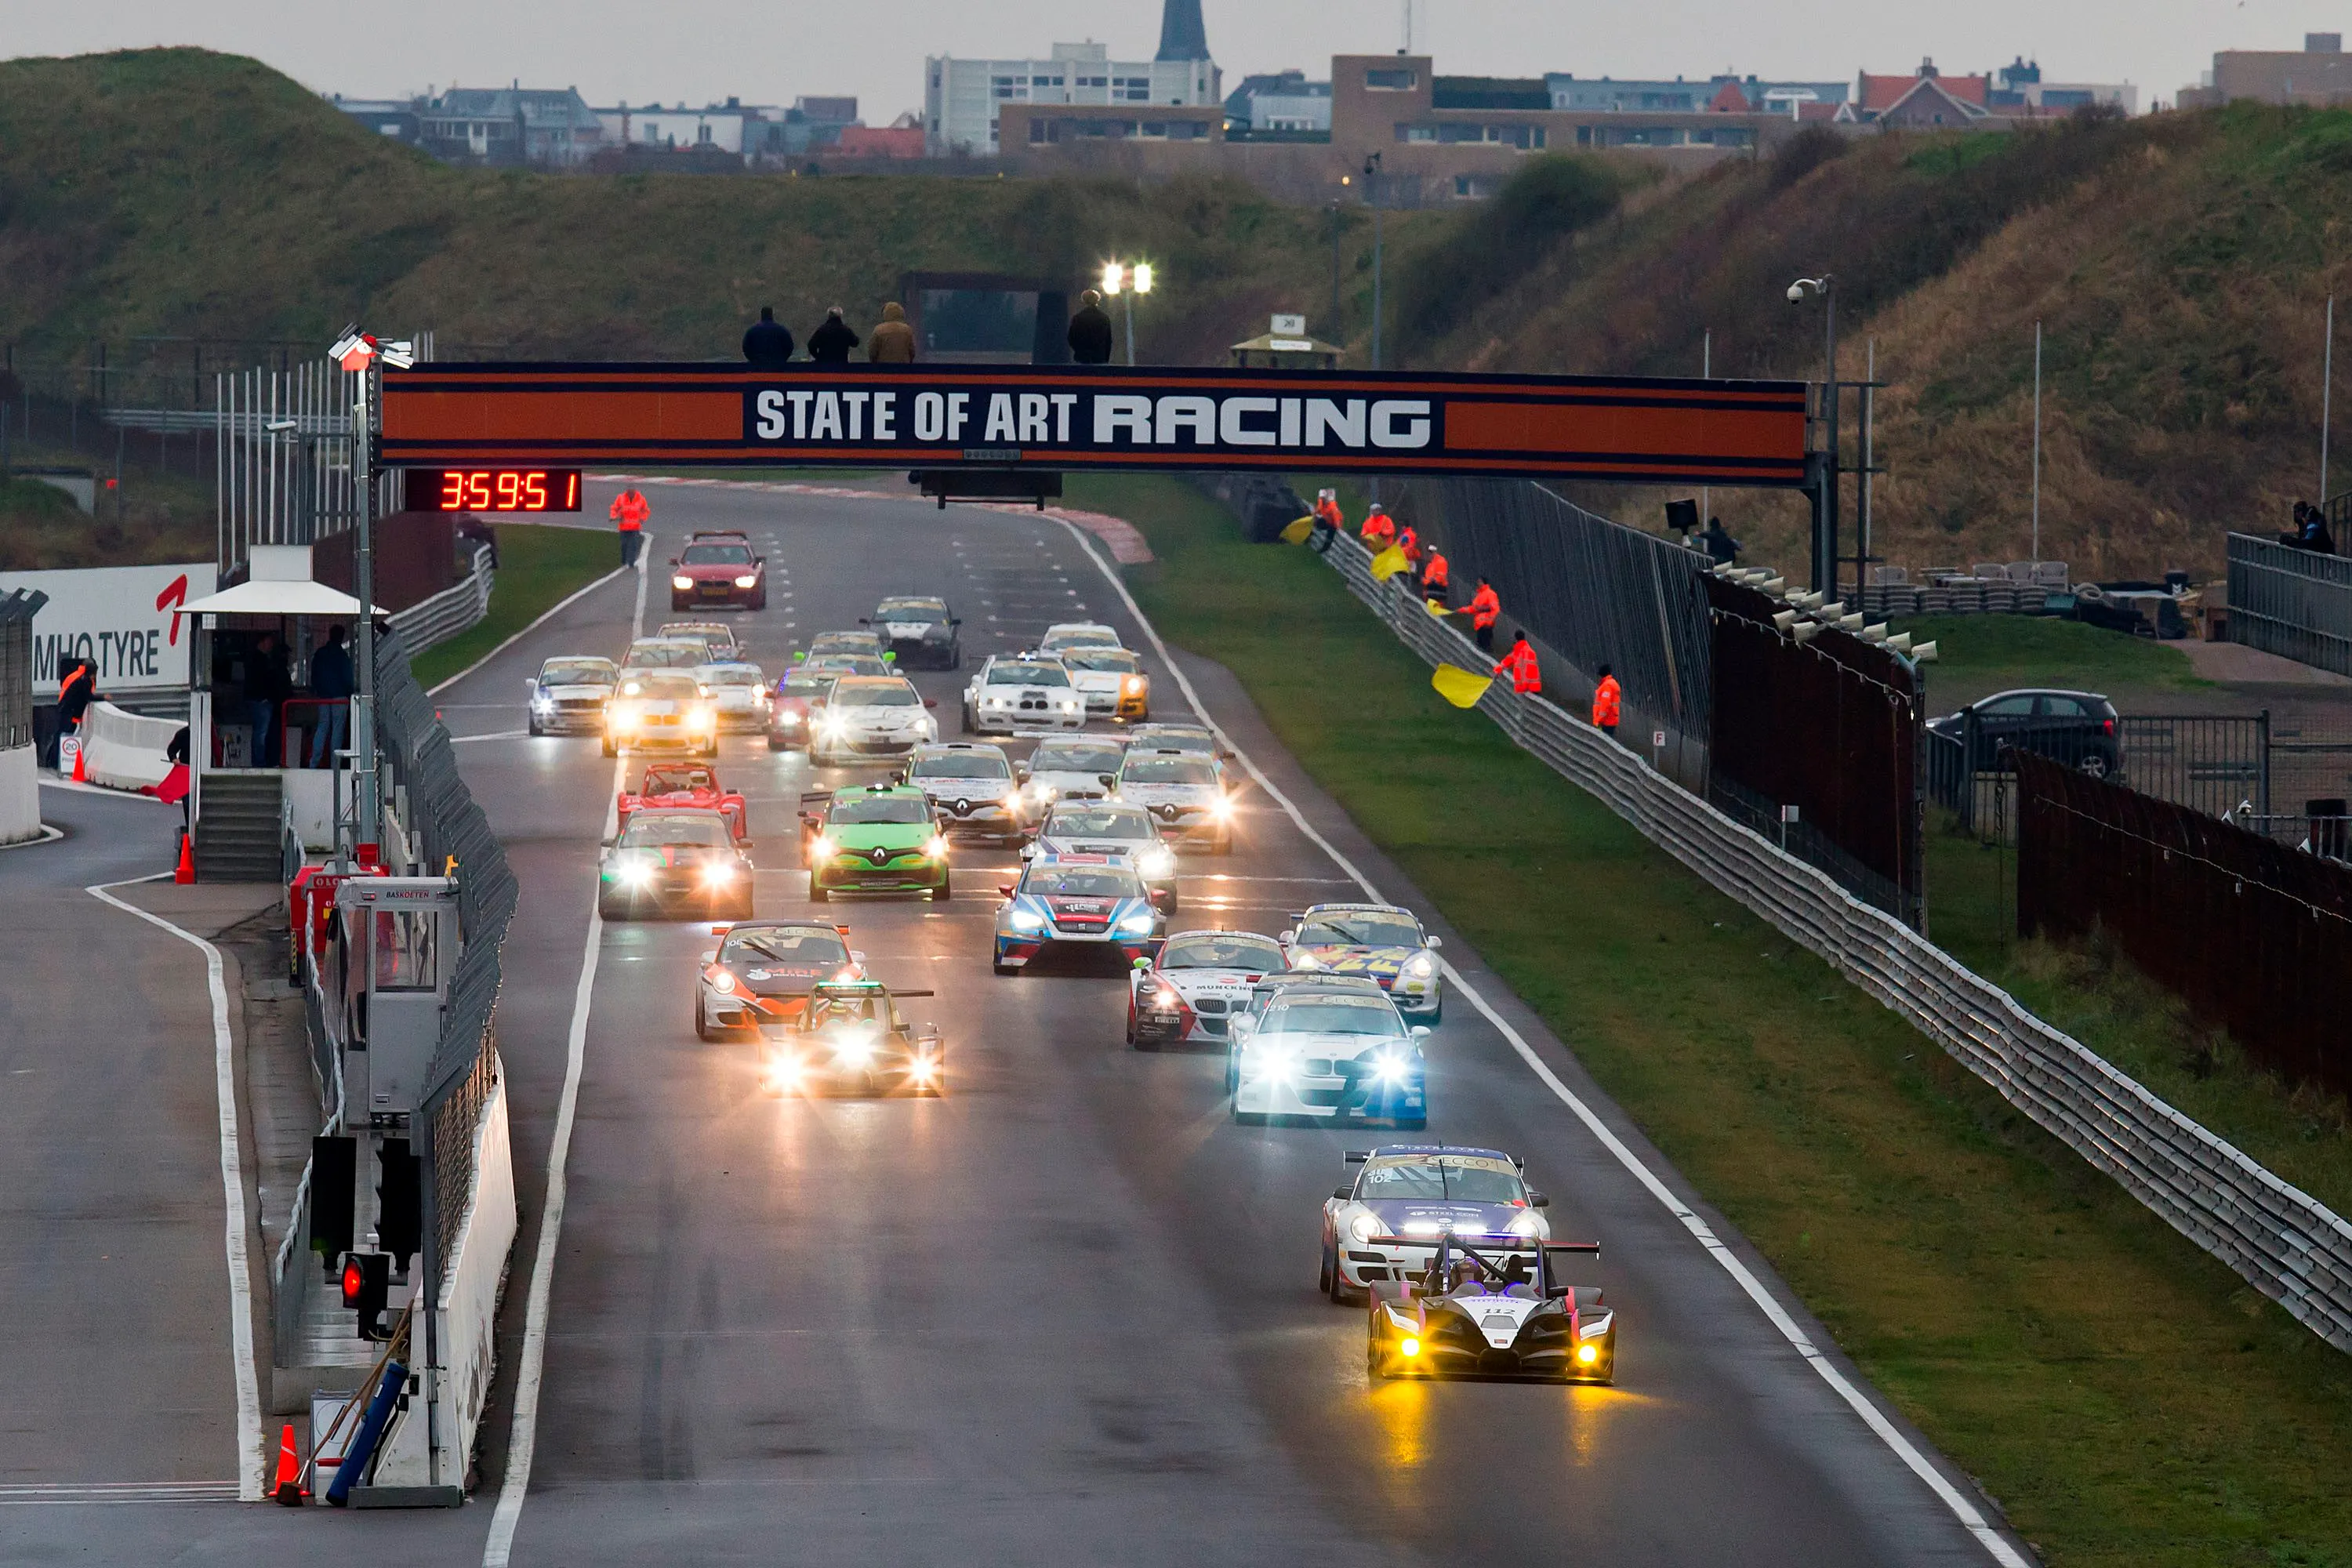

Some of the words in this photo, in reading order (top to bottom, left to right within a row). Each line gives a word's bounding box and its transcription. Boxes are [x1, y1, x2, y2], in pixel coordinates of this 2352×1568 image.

[757, 390, 896, 440] STATE
[914, 392, 969, 441] OF
[984, 394, 1077, 441] ART
[1094, 394, 1430, 448] RACING
[441, 470, 576, 510] 3:59:51
[99, 630, 160, 677] TYRE
[1656, 732, 1663, 745] F
[1369, 1175, 1392, 1185] 102
